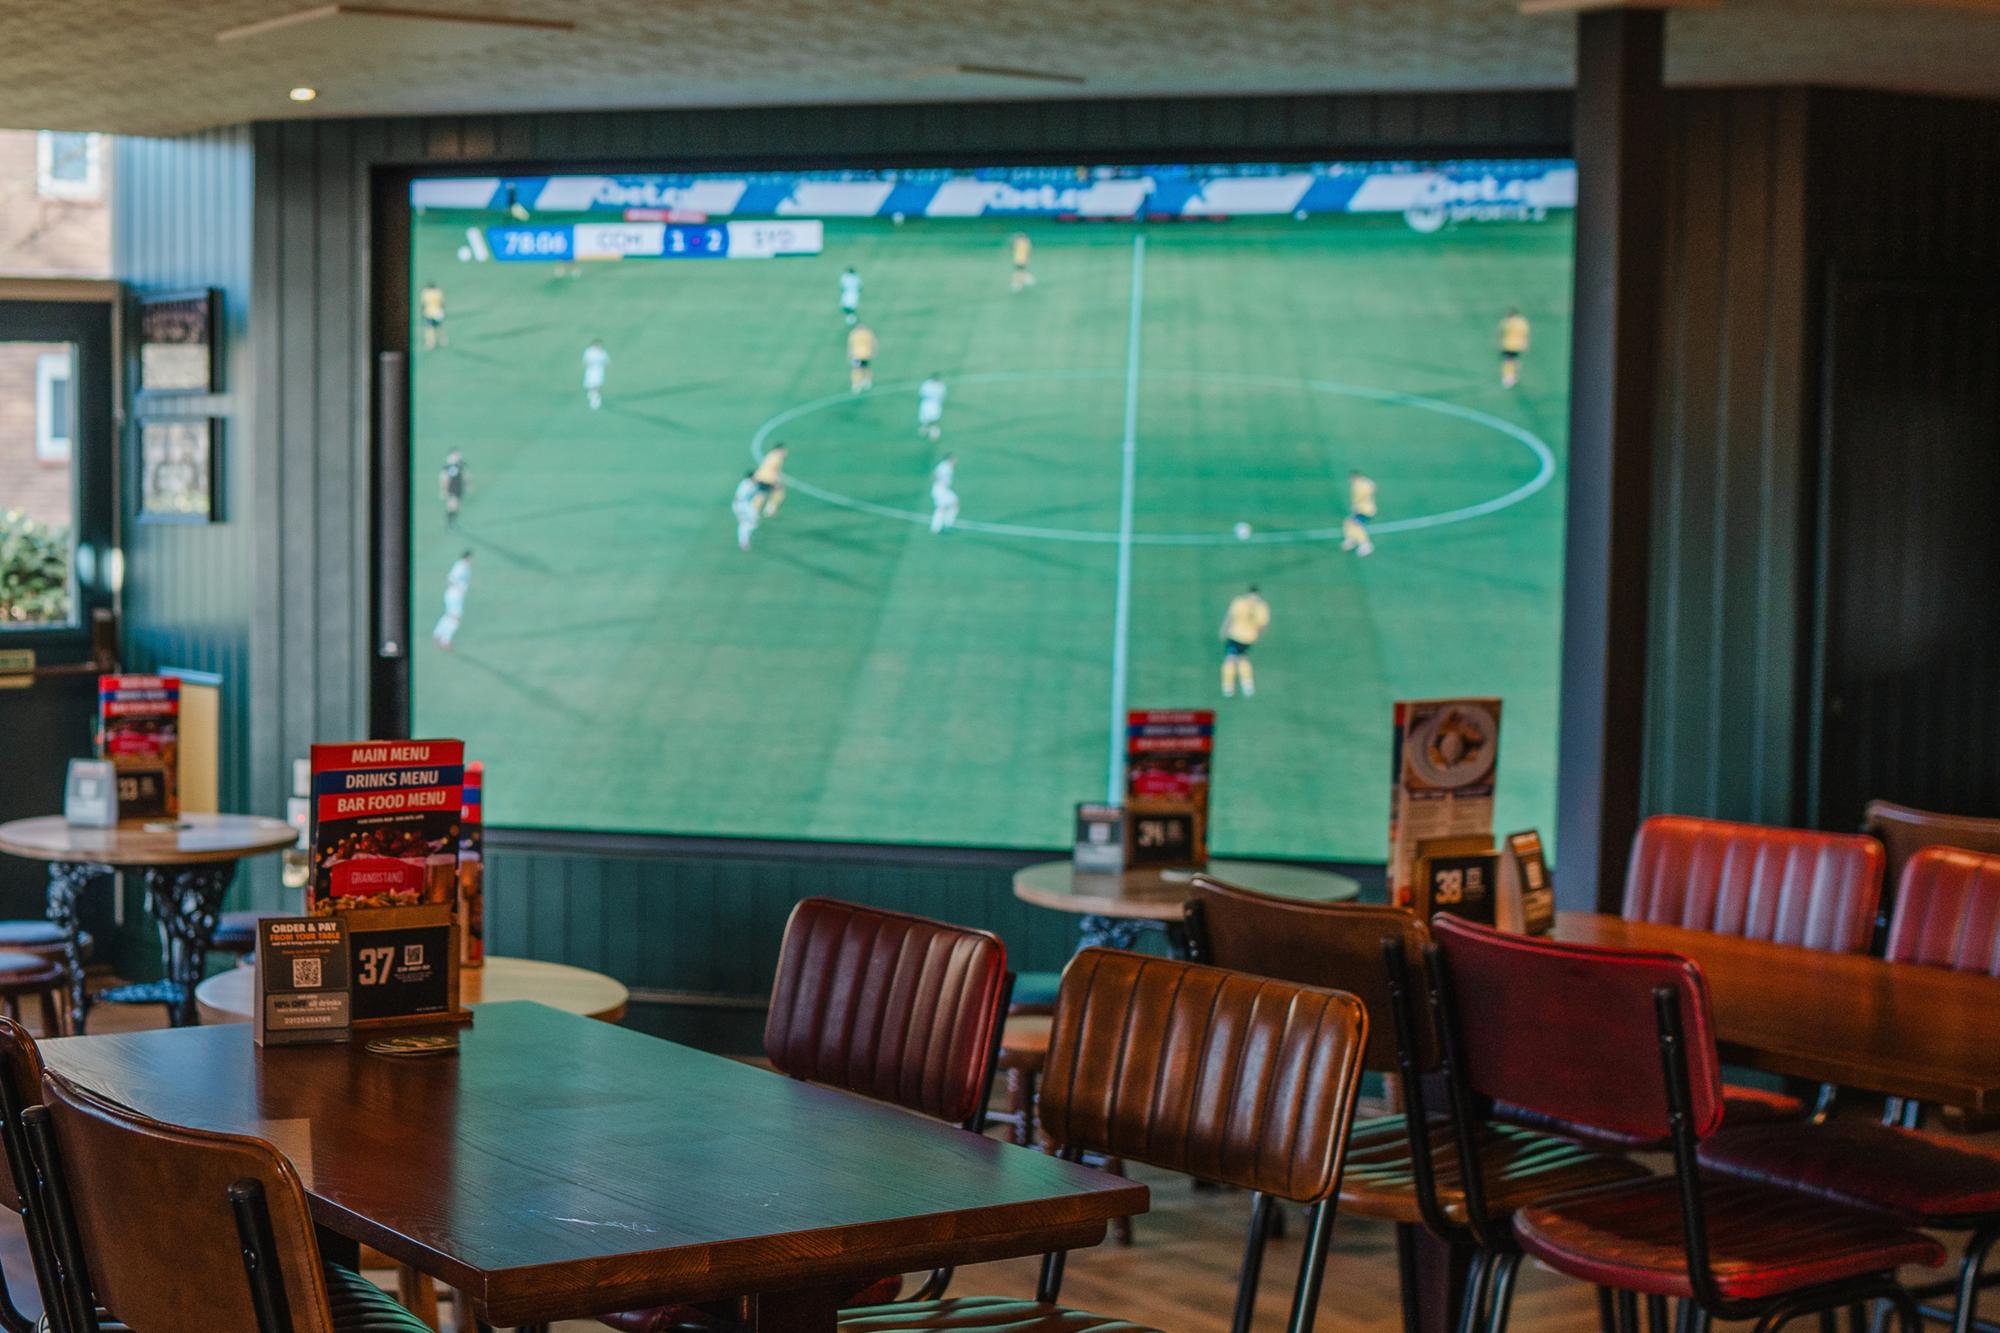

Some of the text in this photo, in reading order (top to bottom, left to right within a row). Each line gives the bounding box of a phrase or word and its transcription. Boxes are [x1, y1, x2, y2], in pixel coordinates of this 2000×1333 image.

[351, 746, 431, 764] MAIN MENU
[345, 770, 439, 789] DRINKS MENU
[337, 791, 446, 813] BAR FOOD MENU
[271, 922, 306, 934] ORDER
[318, 922, 337, 932] PAY
[358, 946, 395, 986] 37
